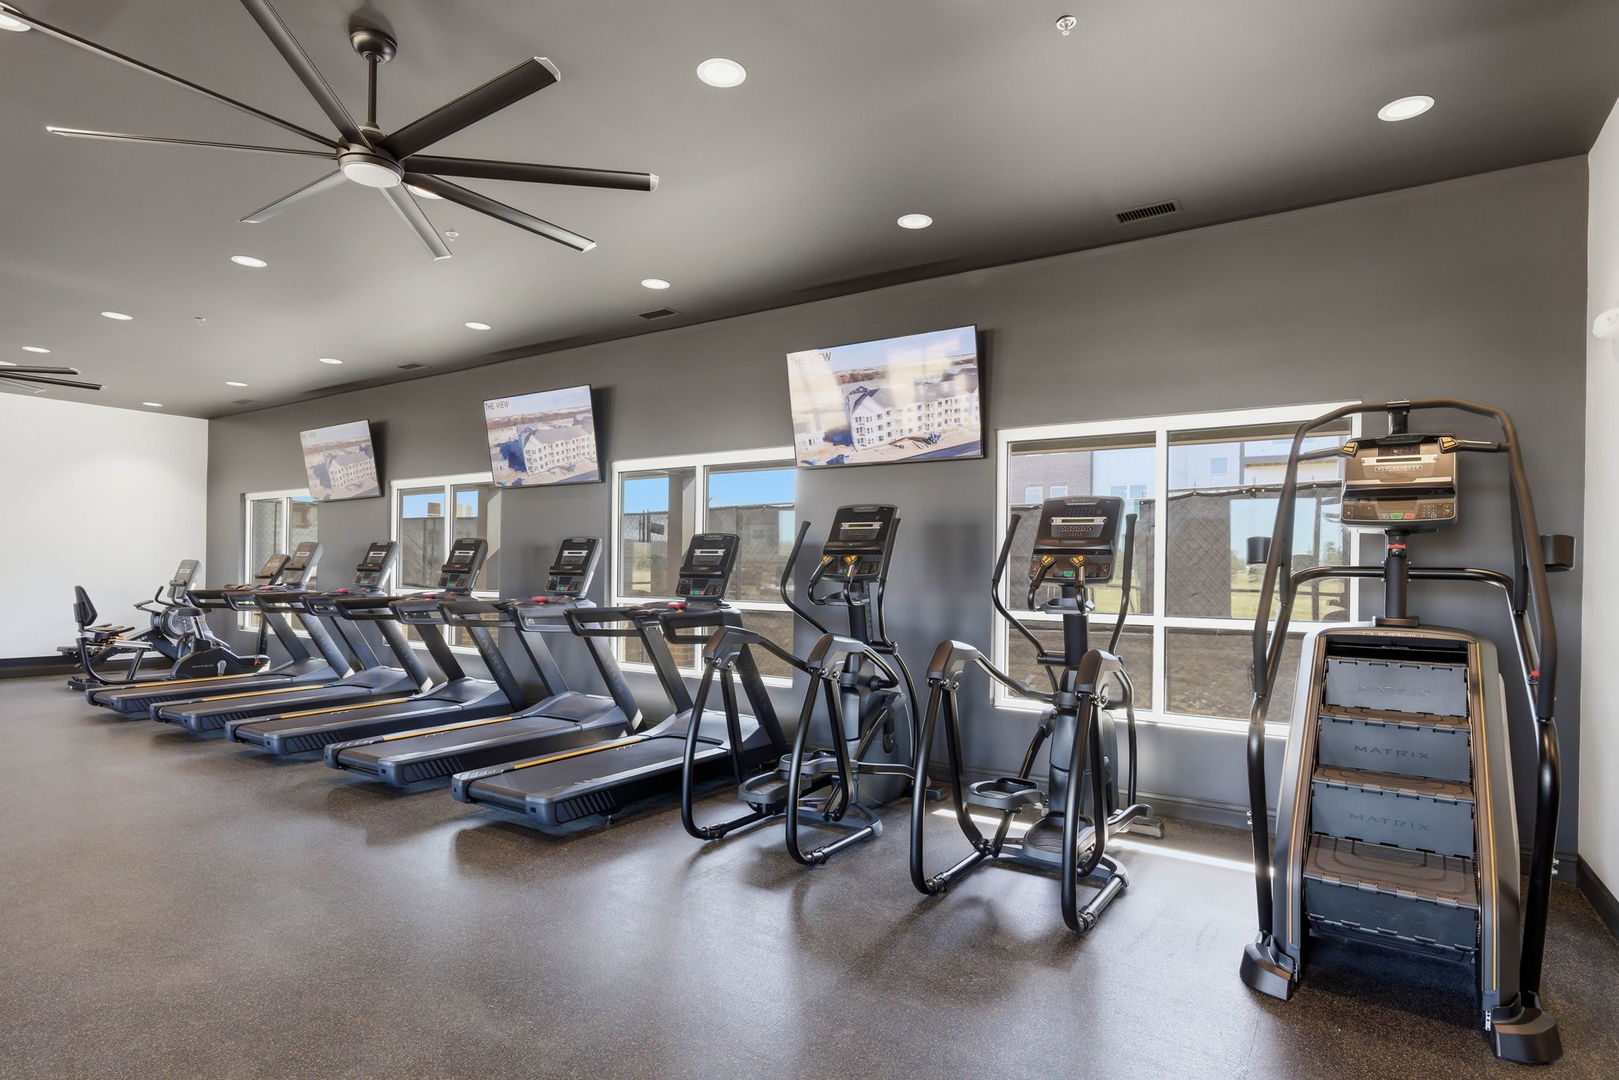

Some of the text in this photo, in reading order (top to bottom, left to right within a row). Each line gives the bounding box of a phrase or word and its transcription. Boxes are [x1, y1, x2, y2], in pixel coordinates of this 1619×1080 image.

[485, 400, 510, 411] THE VIEW
[1354, 744, 1429, 760] MATRIX
[1349, 812, 1430, 832] MATRIX
